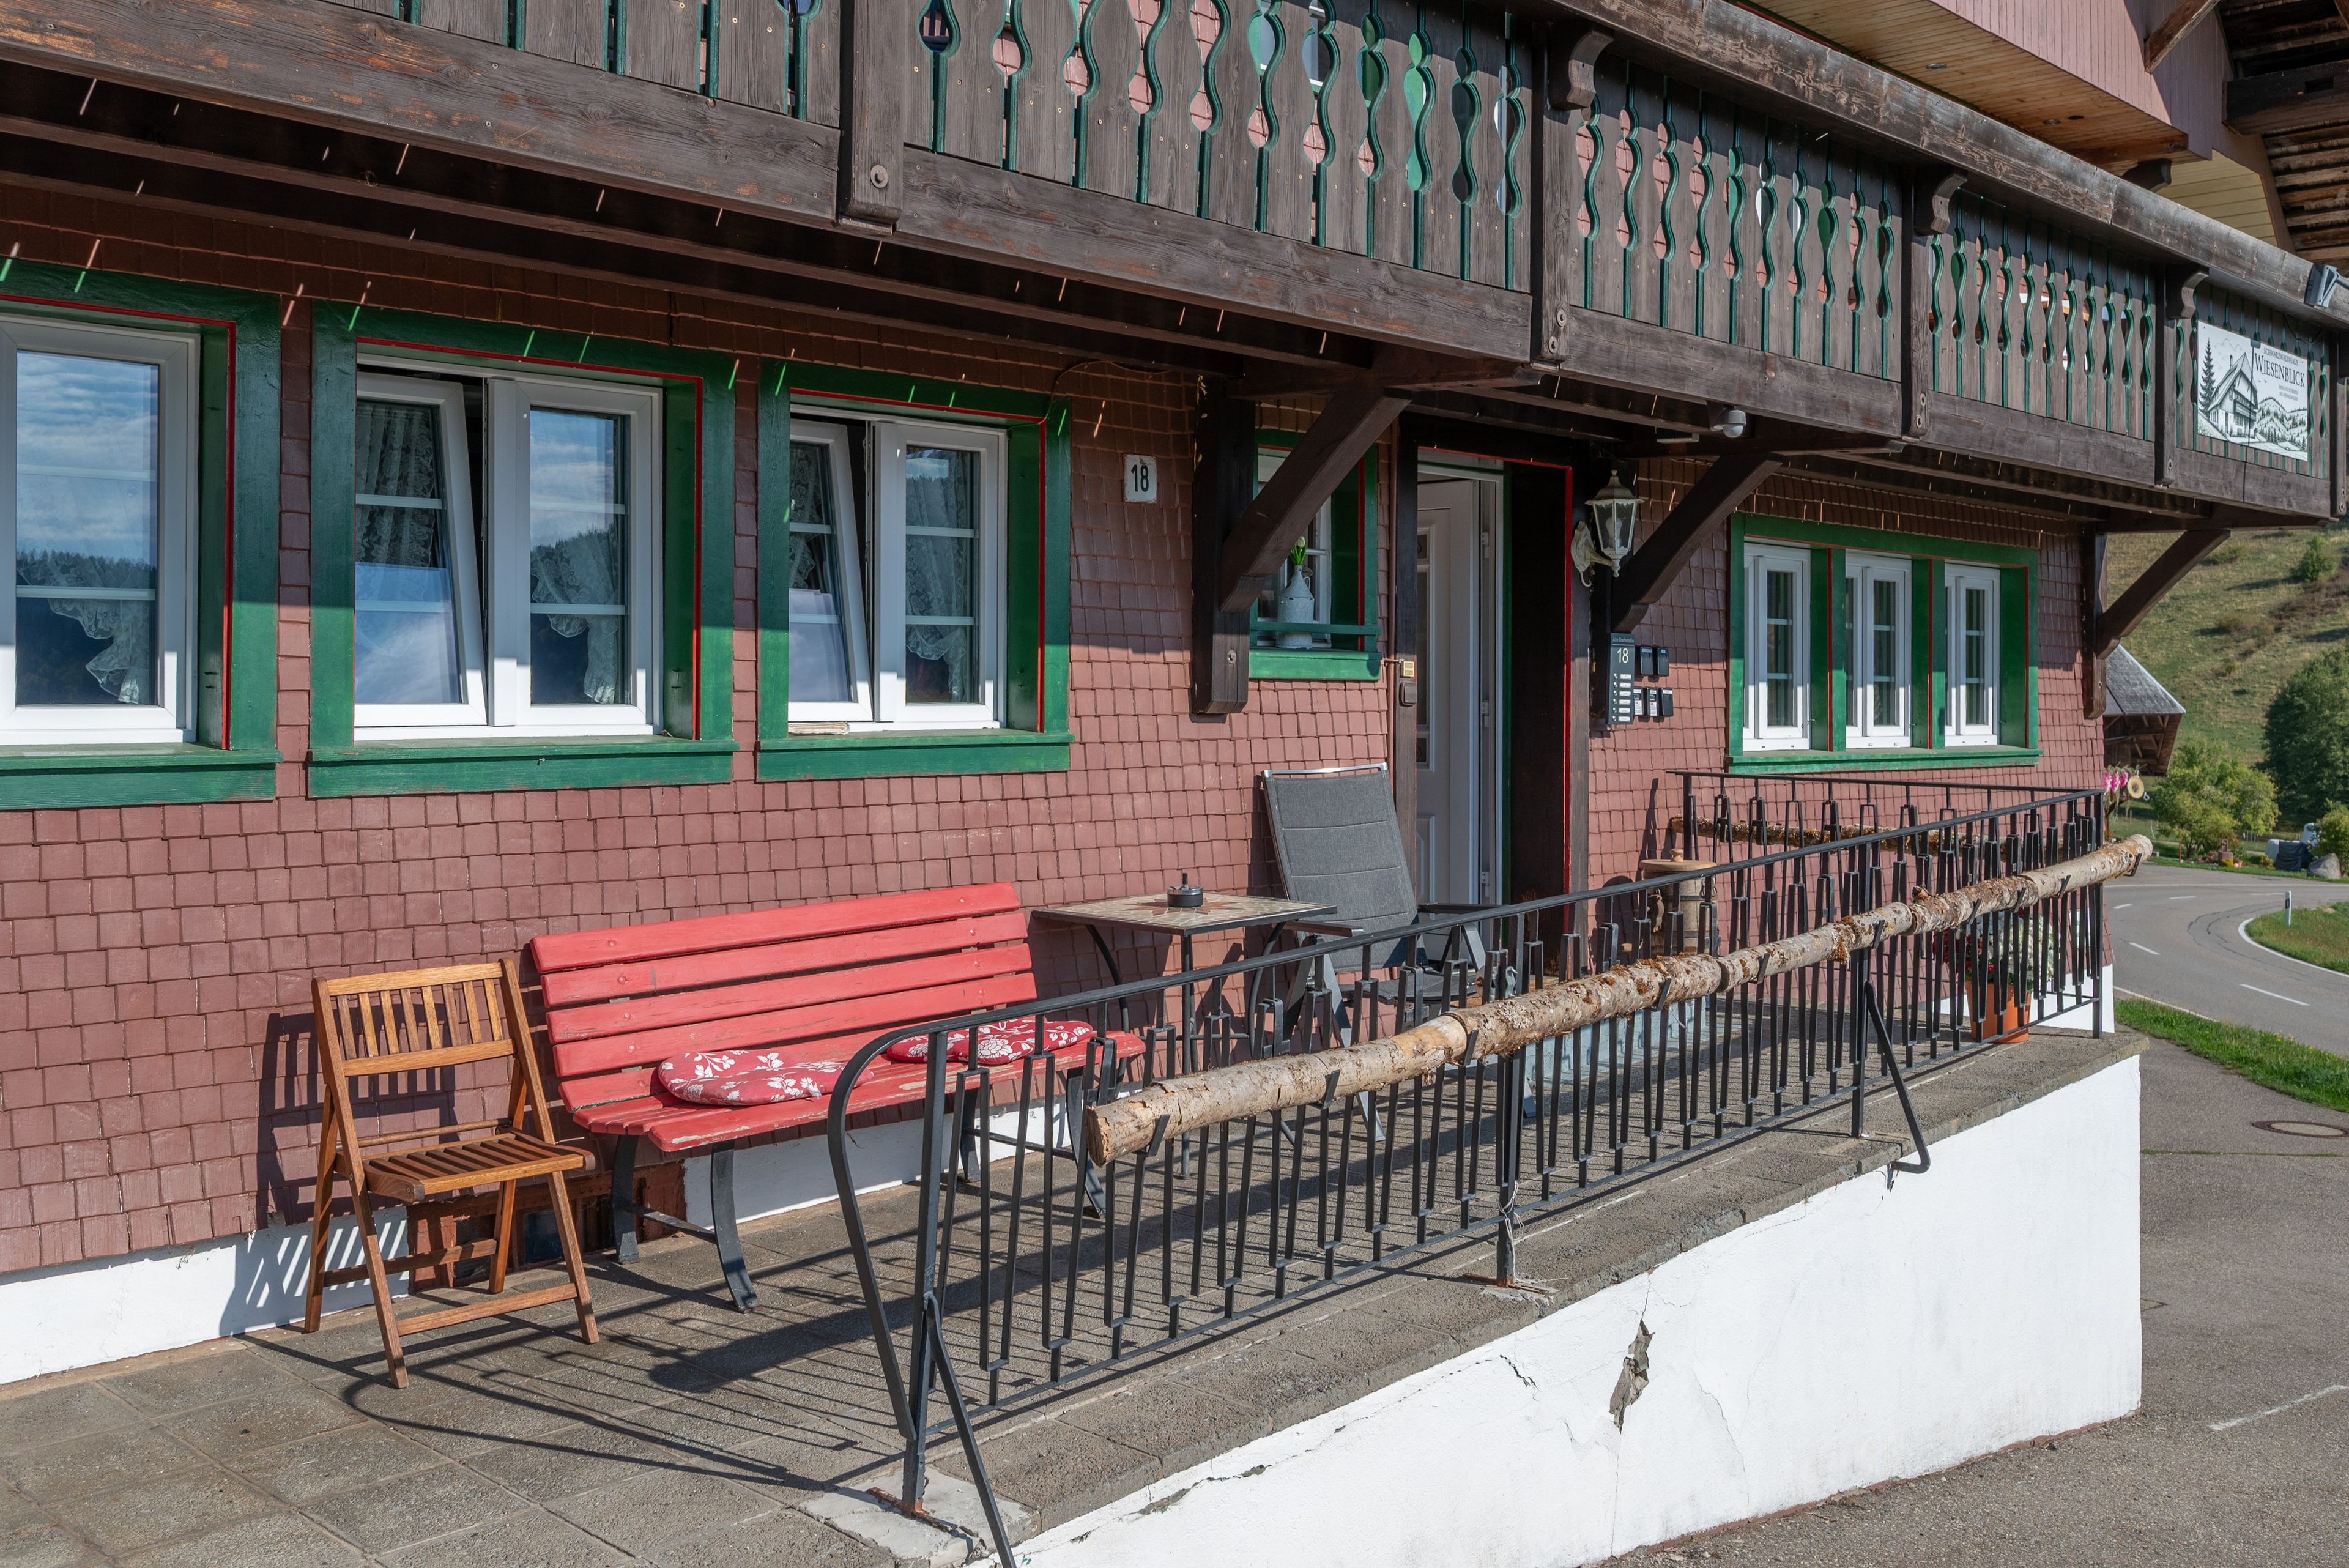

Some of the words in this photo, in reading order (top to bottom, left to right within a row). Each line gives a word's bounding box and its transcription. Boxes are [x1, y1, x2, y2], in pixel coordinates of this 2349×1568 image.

[2263, 347, 2298, 366] SCHWARZWALDHAUS
[1130, 464, 1149, 492] 18
[1617, 647, 1628, 664] 18
